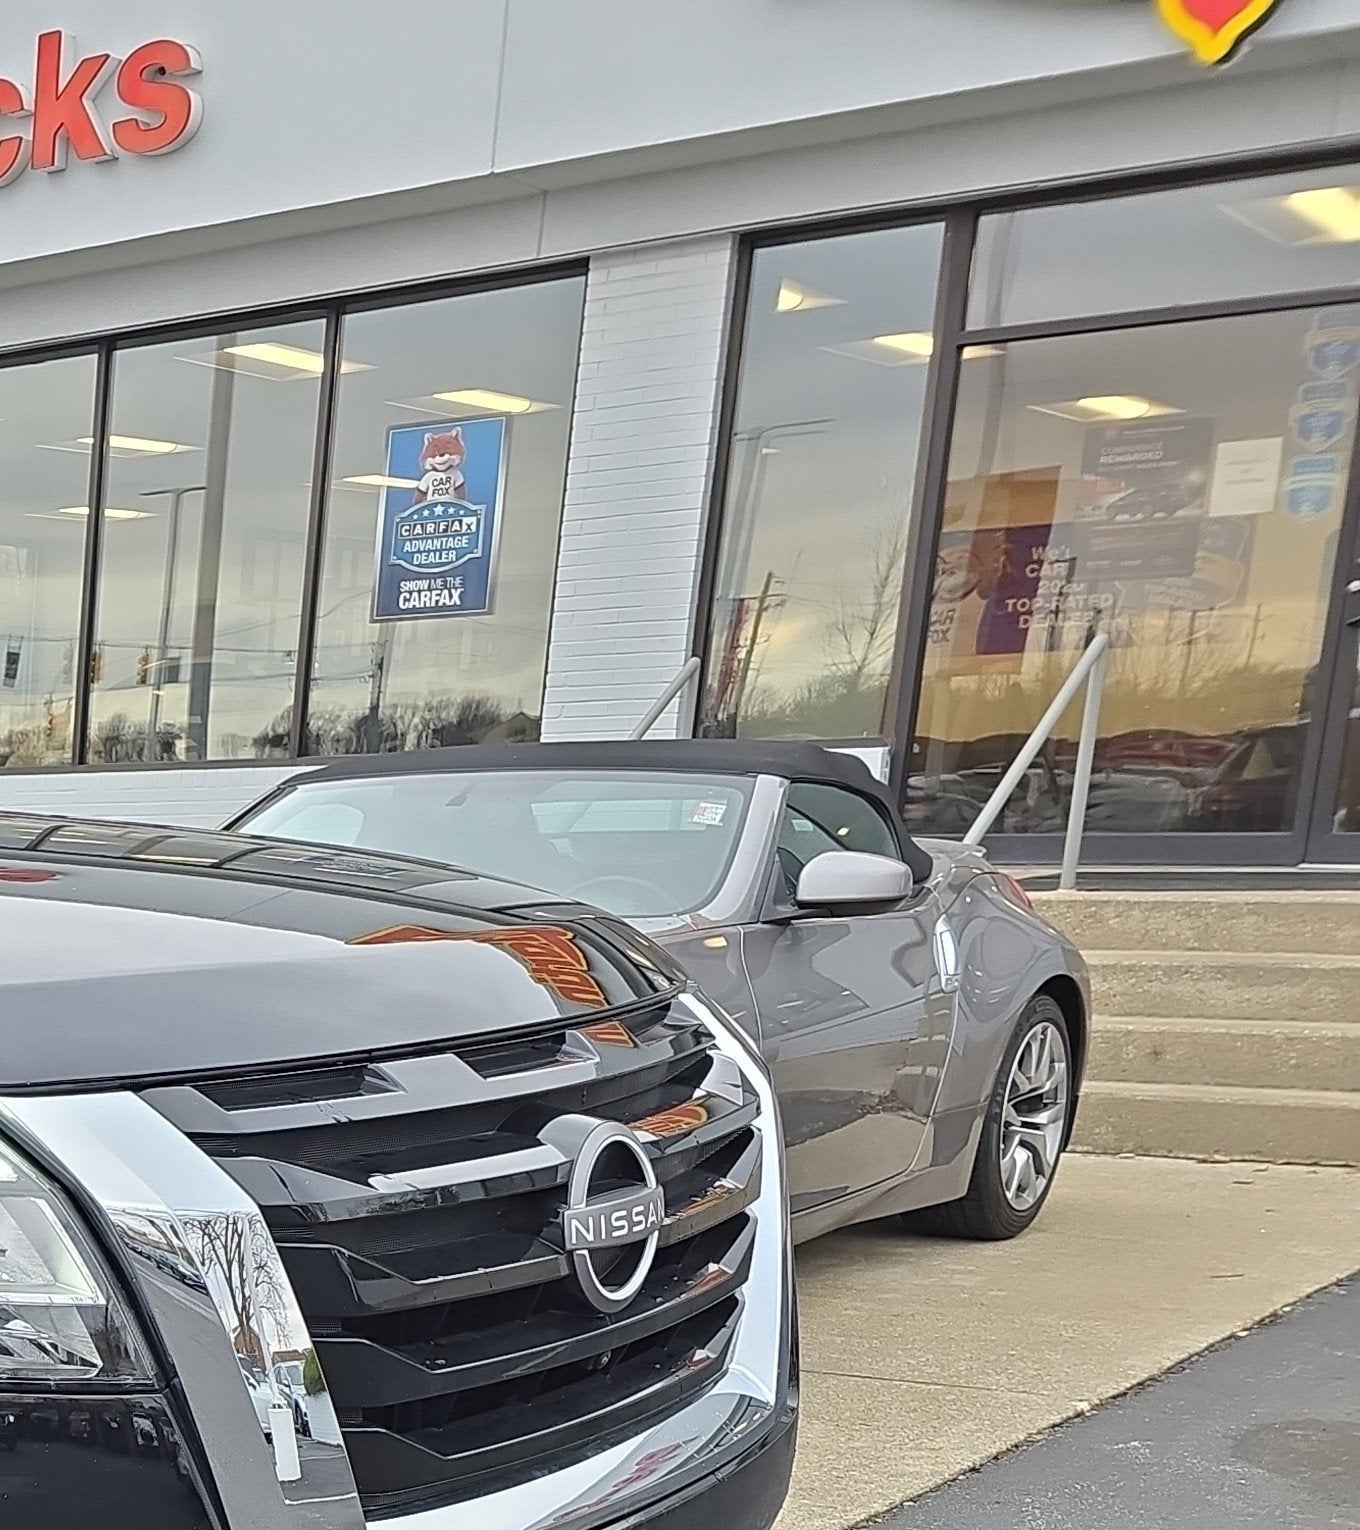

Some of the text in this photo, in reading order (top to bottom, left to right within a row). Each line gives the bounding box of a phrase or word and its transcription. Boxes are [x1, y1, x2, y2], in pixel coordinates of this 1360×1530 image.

[431, 476, 452, 487] CAR
[431, 486, 451, 497] FOX
[400, 517, 476, 537] CARFAX
[403, 535, 470, 552] ADVANTAGE
[413, 550, 457, 565] DEALER
[399, 575, 465, 592] SHOW ME THE
[398, 586, 465, 610] CARFAX
[571, 1198, 665, 1244] NISSAN
